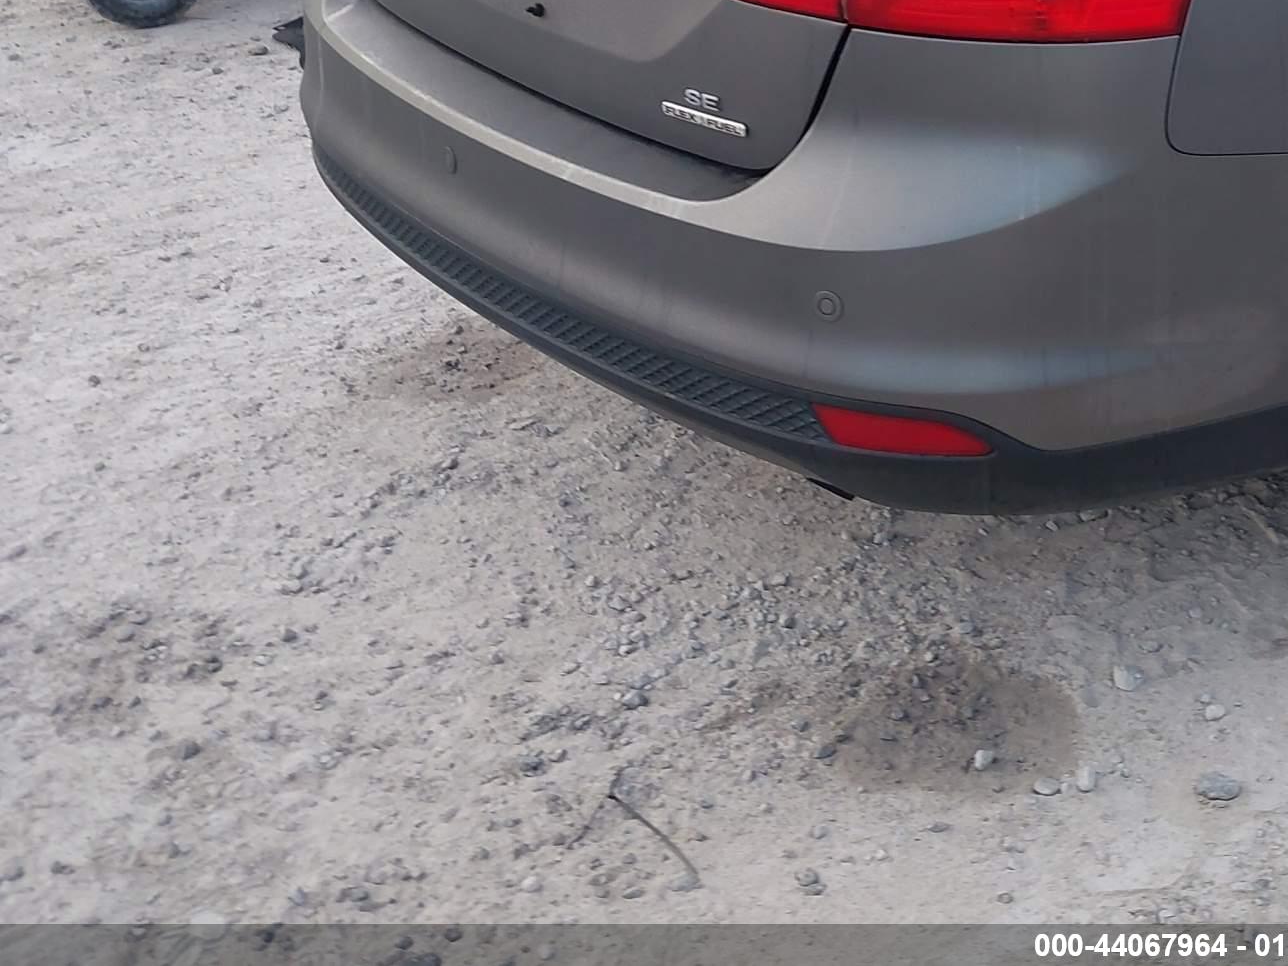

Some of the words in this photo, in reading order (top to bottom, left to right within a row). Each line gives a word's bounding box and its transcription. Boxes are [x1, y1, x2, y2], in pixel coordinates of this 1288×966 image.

[684, 88, 720, 112] SE
[664, 104, 698, 124] FLEX
[705, 118, 743, 136] FUEL
